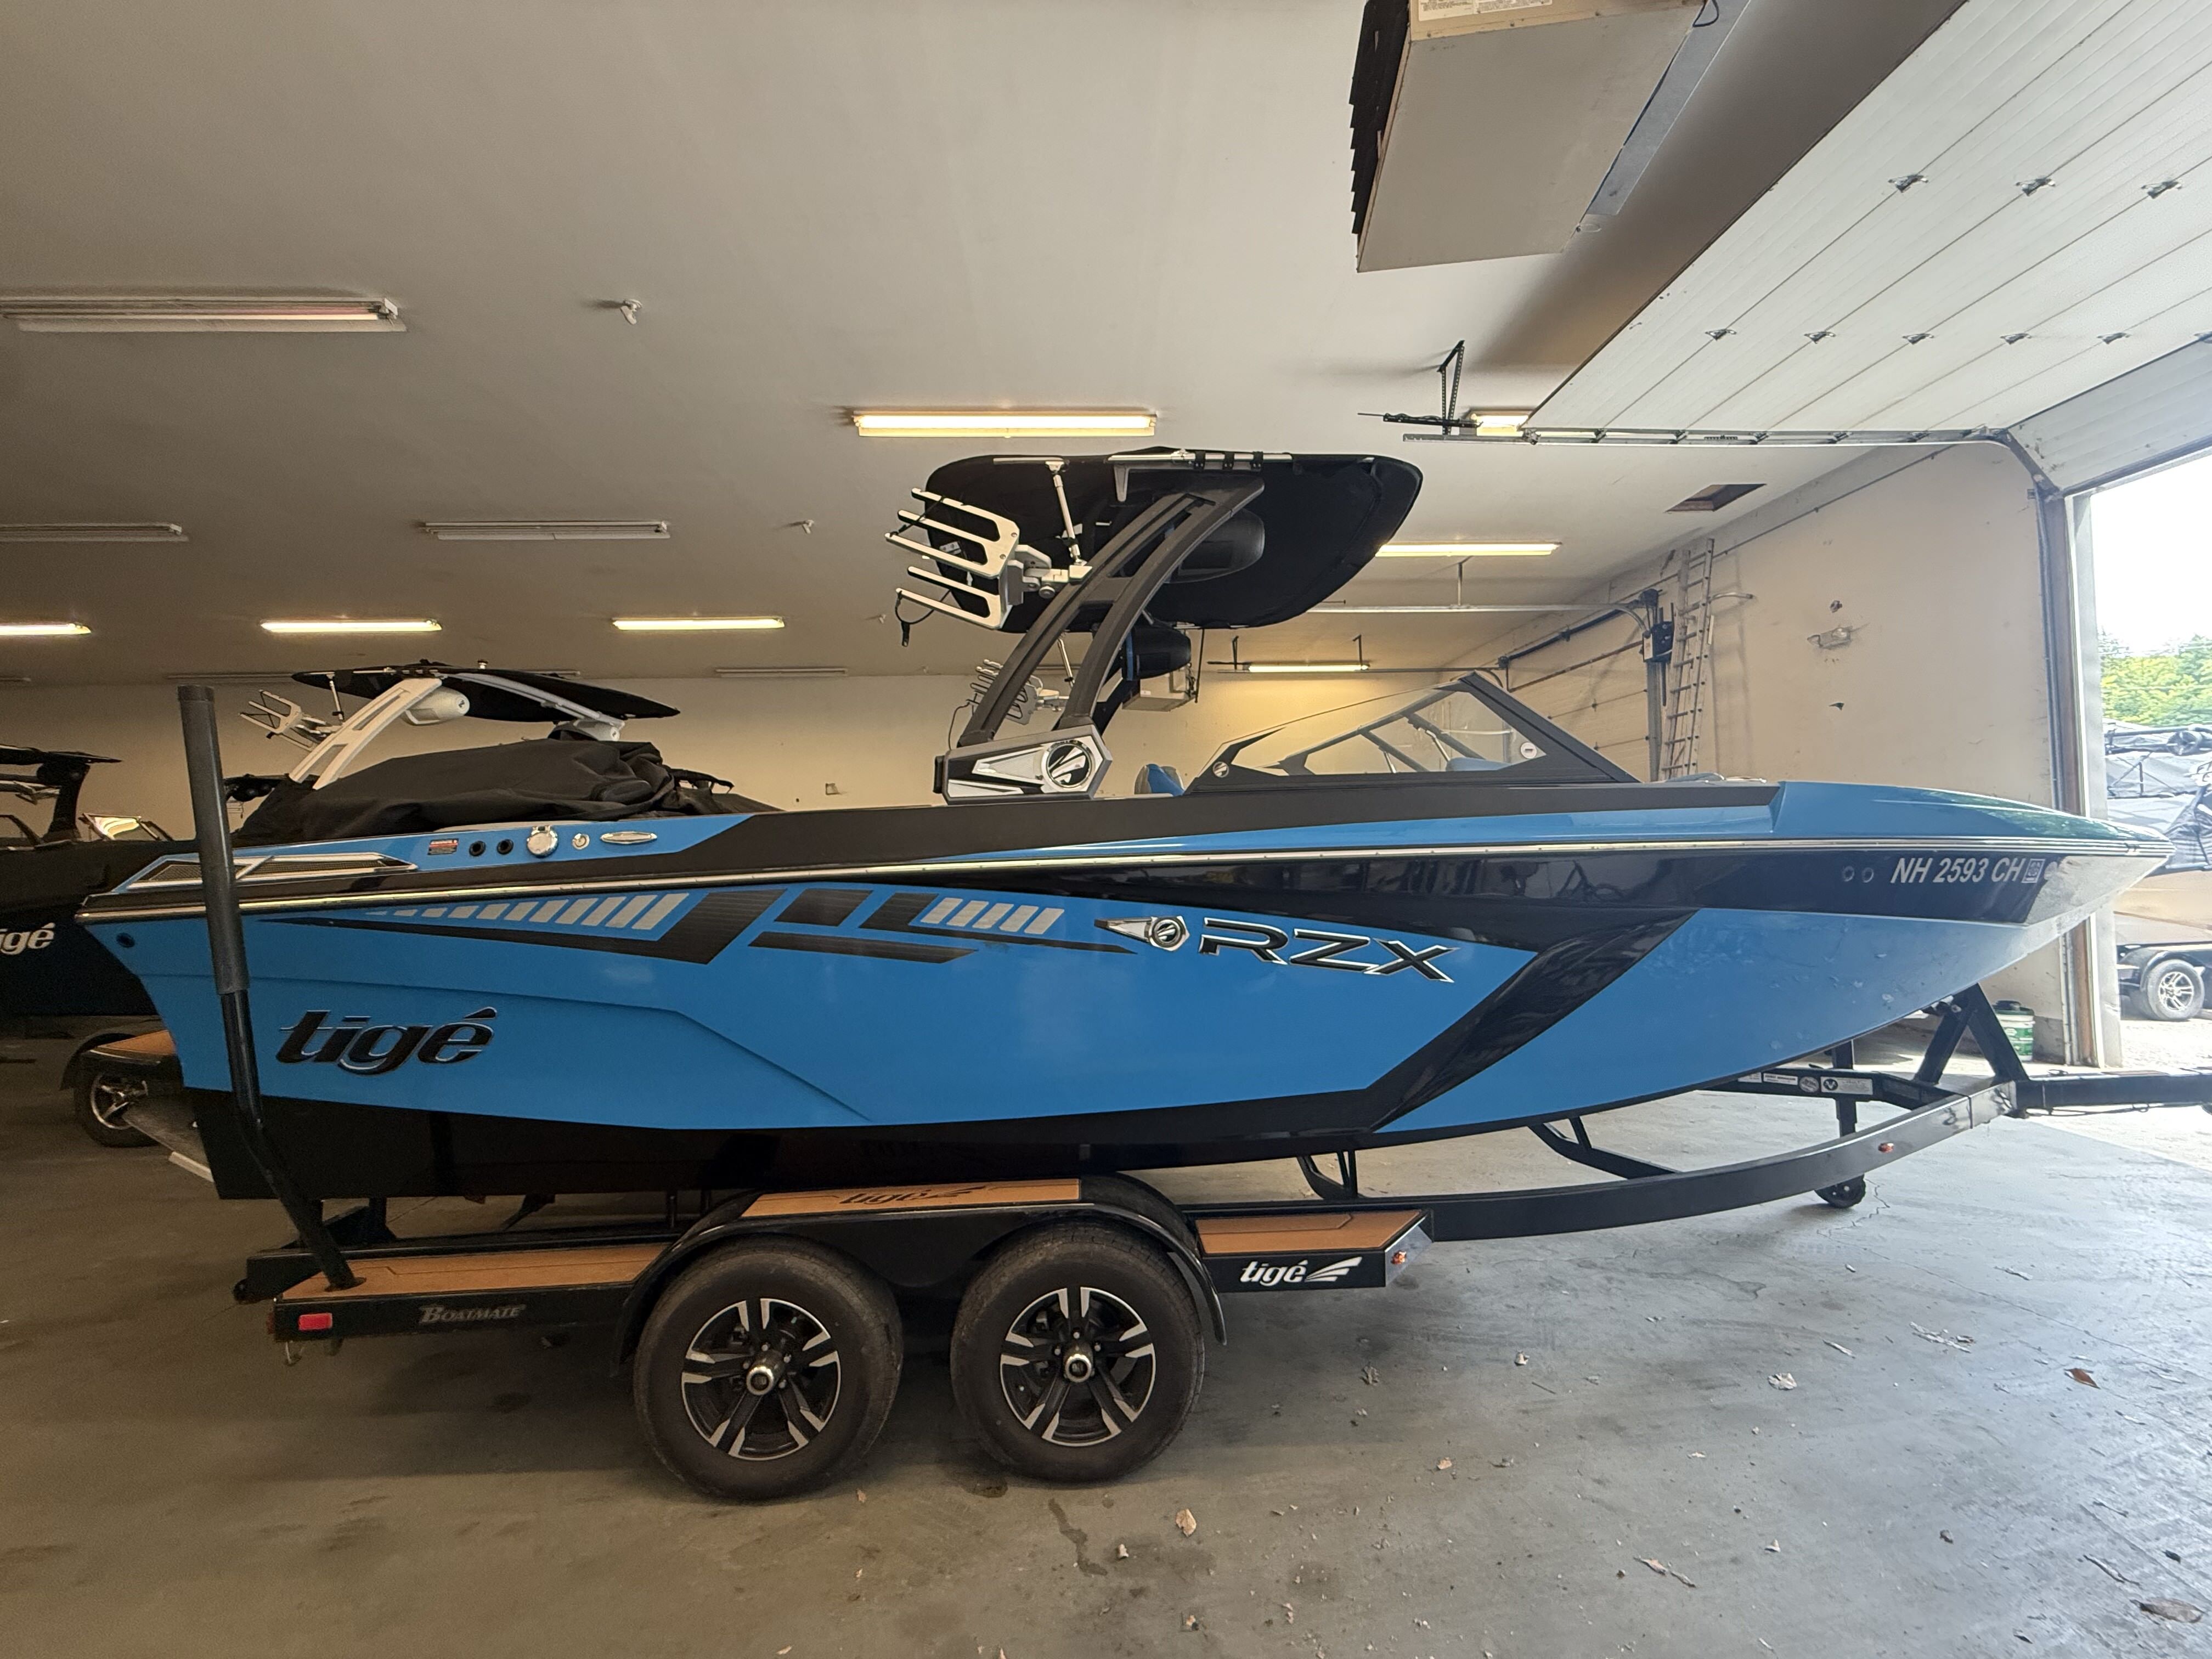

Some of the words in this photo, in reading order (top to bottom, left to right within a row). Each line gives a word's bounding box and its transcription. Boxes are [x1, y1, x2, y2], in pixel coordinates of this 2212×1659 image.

[1891, 857, 1933, 883] NH
[1933, 857, 1989, 883] 2593
[1991, 857, 2027, 882] CH
[1198, 917, 1460, 984] RZX
[275, 1006, 498, 1076] tigé
[1240, 1260, 1308, 1286] tigé
